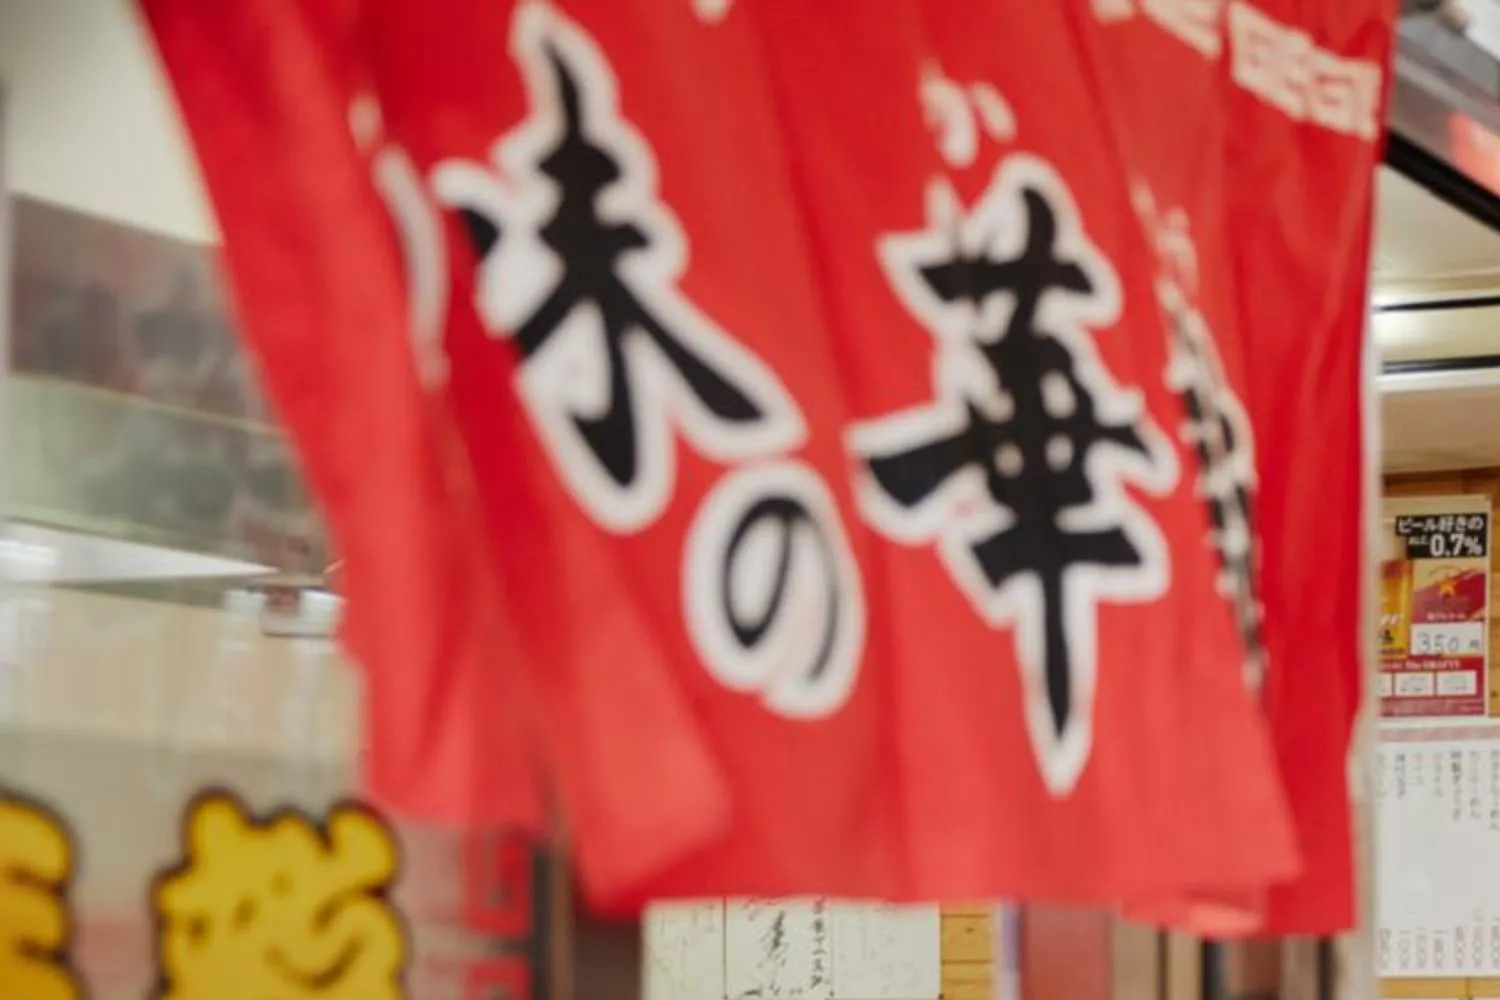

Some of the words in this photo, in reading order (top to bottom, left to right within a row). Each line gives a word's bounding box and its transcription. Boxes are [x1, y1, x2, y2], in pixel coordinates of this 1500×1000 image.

[1398, 515, 1484, 533] ビール好きの
[1430, 533, 1483, 556] 0.7%
